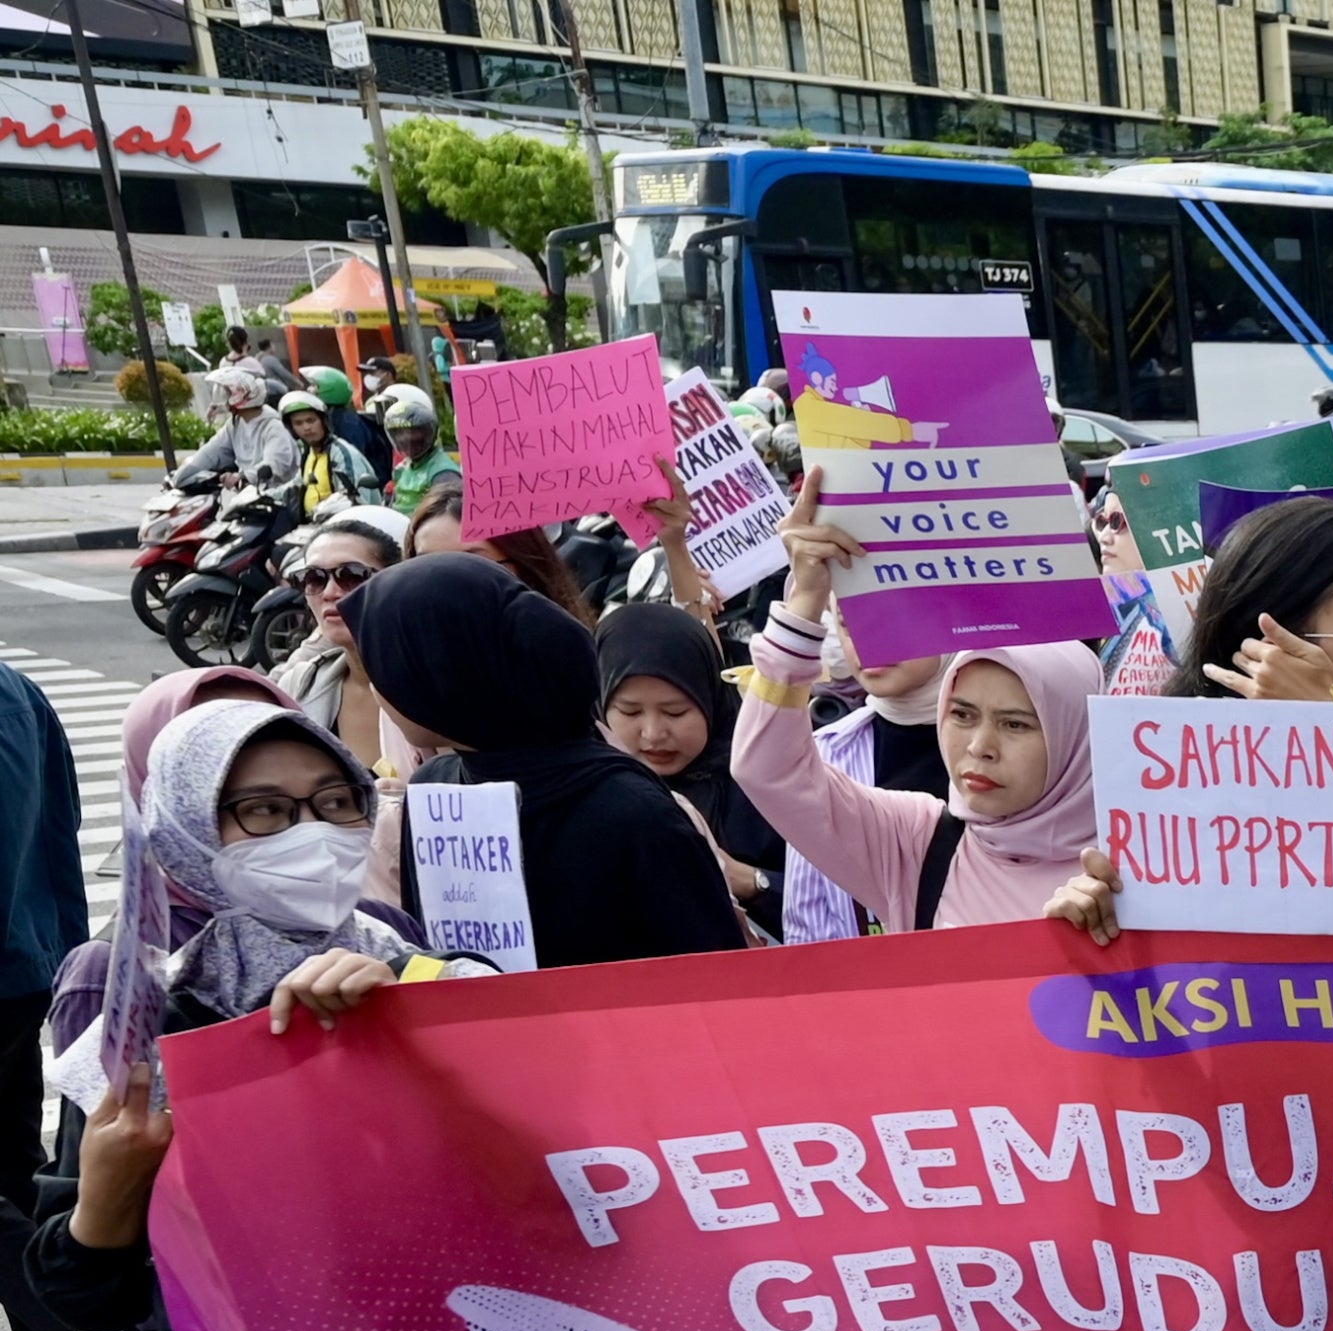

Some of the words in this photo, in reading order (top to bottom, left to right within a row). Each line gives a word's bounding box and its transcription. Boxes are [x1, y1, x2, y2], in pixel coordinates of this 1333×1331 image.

[984, 266, 1000, 282] TJ
[1003, 267, 1029, 283] 374
[462, 347, 656, 428] PEMBALUT
[465, 421, 576, 474] MAKIN
[581, 402, 666, 451] MAHAL
[468, 454, 659, 500] MENSTRUAS
[871, 456, 982, 493] your
[468, 499, 592, 522] MAKIN
[879, 502, 1010, 535] voice
[872, 554, 1055, 585] matters
[427, 791, 464, 822] UU
[415, 834, 513, 873] CIPTAKER
[1106, 808, 1202, 886] RUU
[430, 919, 526, 953] KEKERASAN
[1085, 977, 1253, 1045] AKSI
